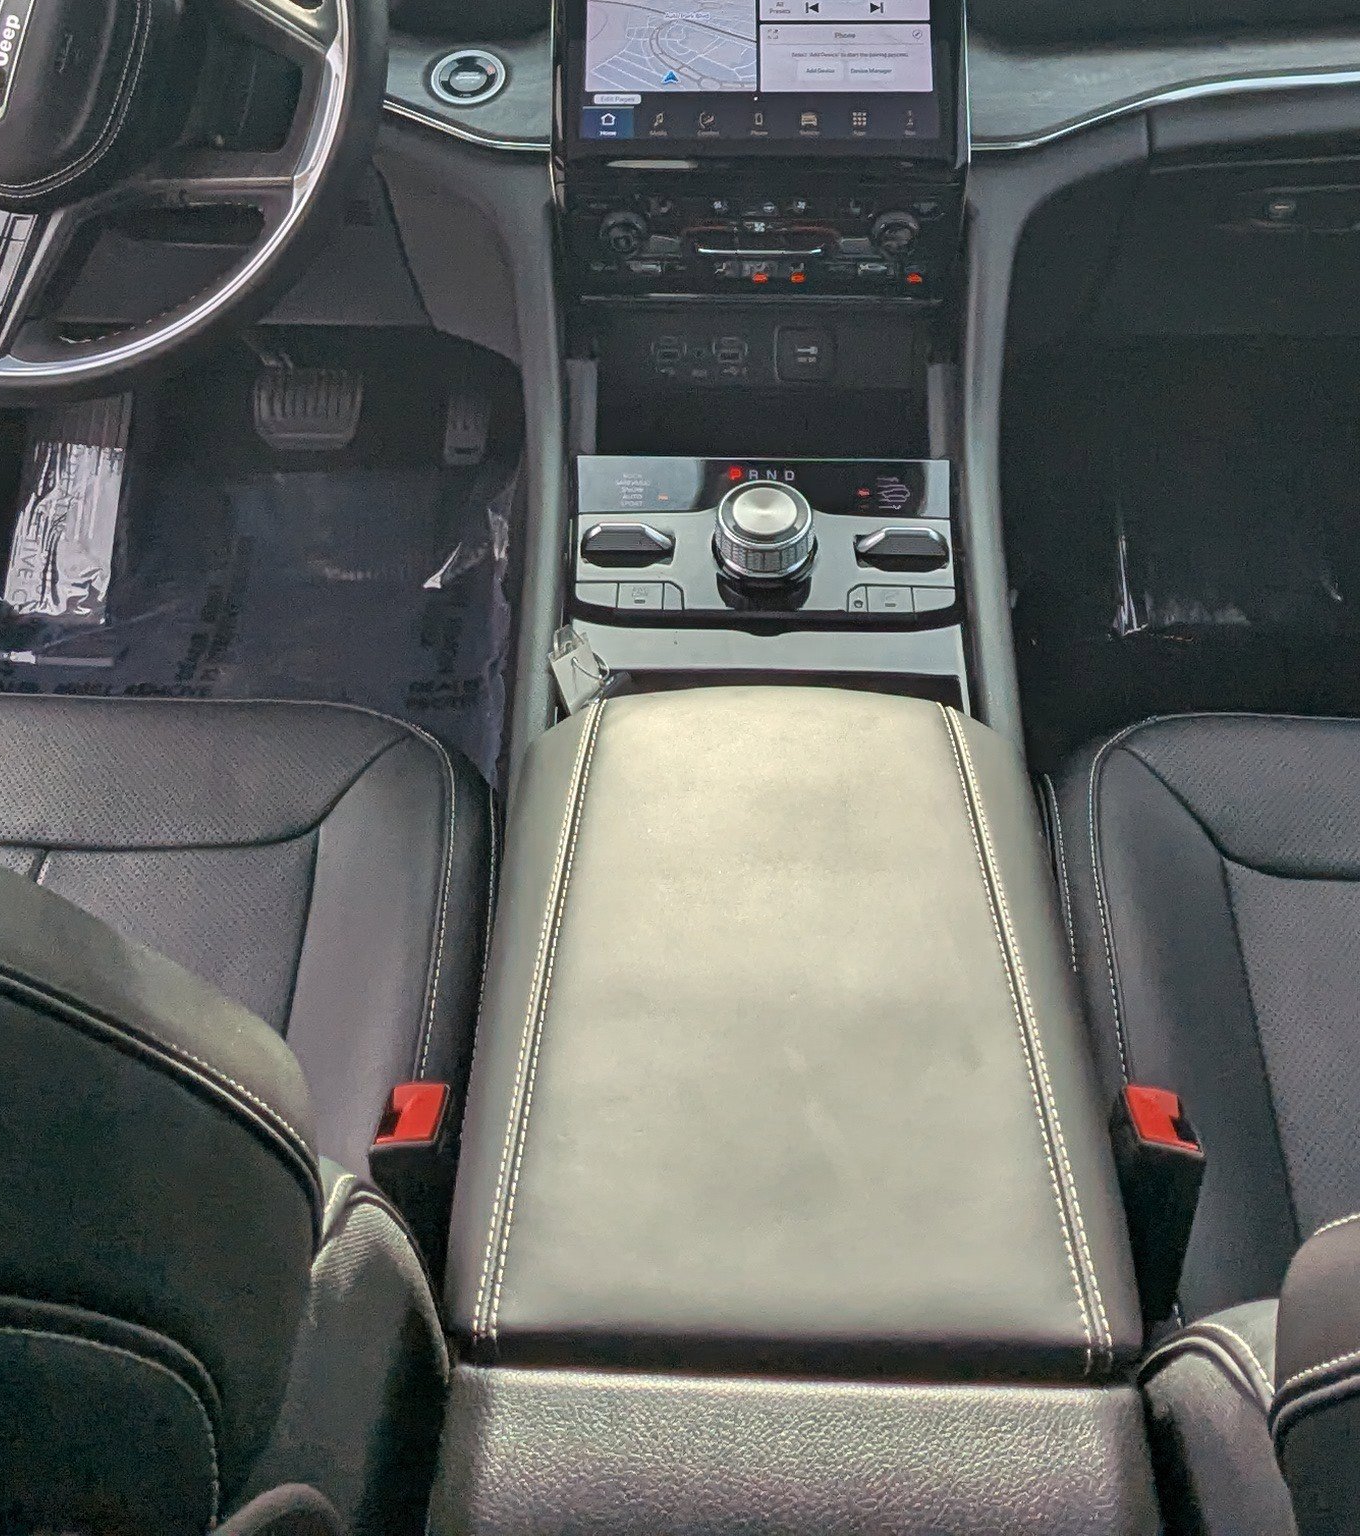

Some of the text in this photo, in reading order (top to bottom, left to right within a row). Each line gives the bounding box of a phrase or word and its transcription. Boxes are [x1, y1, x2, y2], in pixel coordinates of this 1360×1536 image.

[730, 467, 795, 481] P R N D
